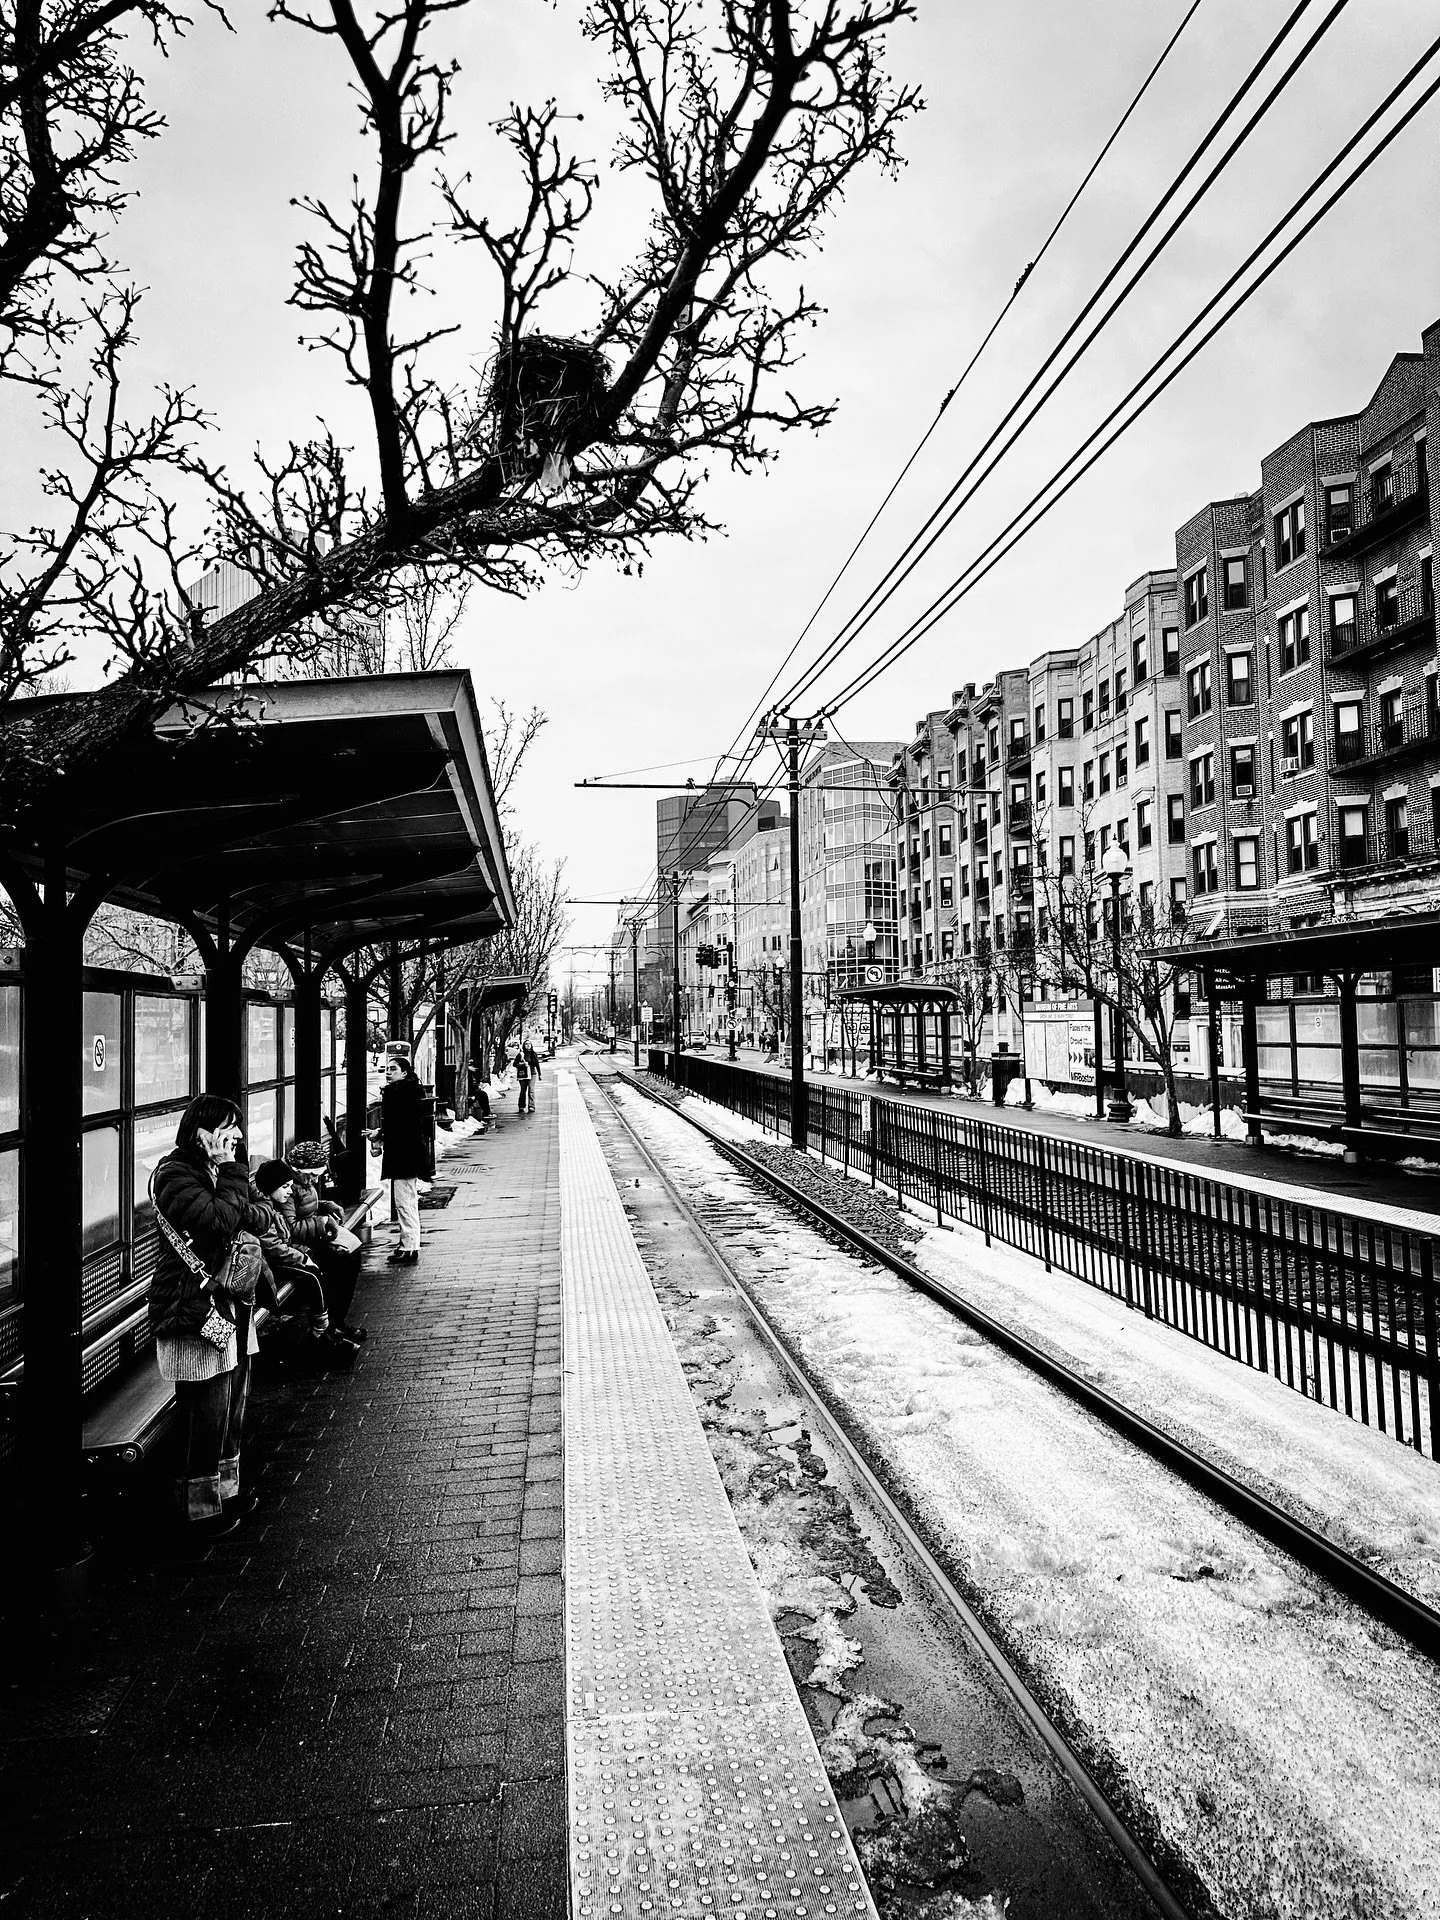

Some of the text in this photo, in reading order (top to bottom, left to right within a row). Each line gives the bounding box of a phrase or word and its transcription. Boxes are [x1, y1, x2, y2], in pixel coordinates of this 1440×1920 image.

[1052, 1002, 1058, 1011] OF
[1058, 1002, 1067, 1010] FINE
[1067, 1002, 1078, 1010] ARTS
